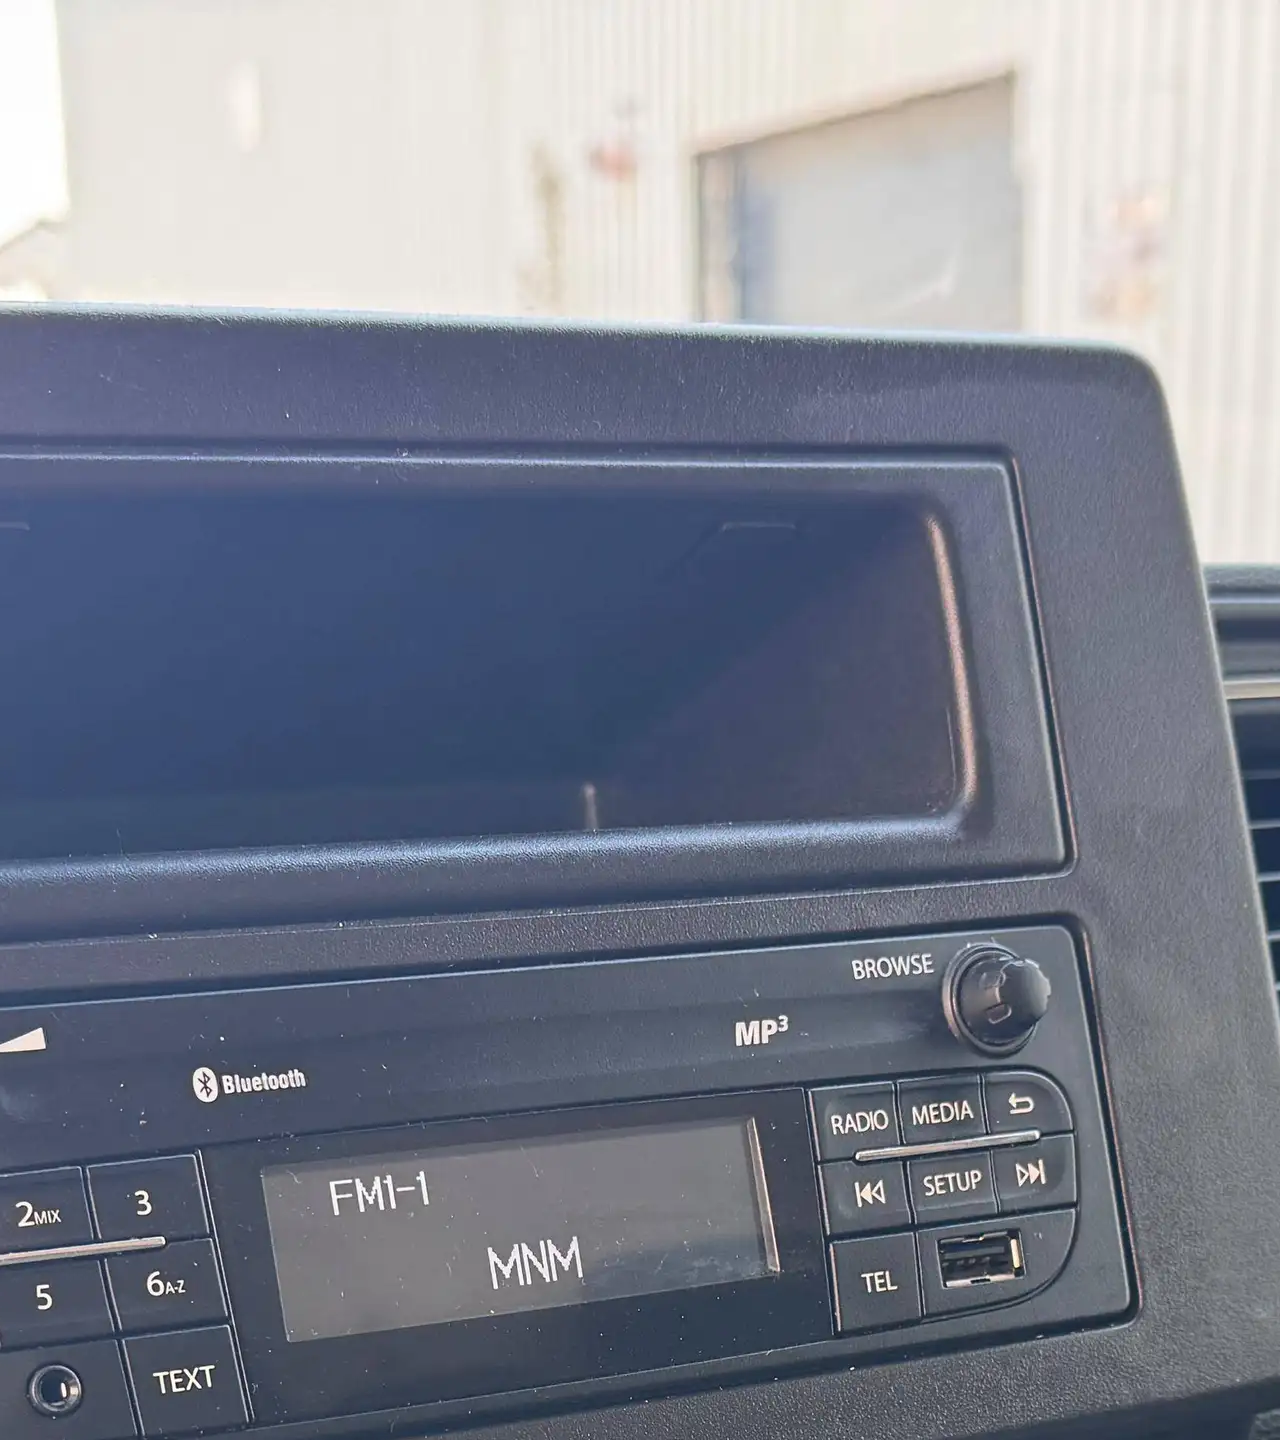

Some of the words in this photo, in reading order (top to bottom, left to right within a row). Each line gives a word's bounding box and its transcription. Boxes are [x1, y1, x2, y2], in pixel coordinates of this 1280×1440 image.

[851, 953, 935, 980] BROWSE
[222, 1068, 306, 1094] Bluetooth
[830, 1109, 889, 1136] RADIO
[911, 1099, 975, 1126] MEDIA
[329, 1170, 430, 1216] FM1-1
[923, 1169, 982, 1197] SETUP
[134, 1190, 152, 1216] 3
[487, 1235, 584, 1290] MNM
[860, 1270, 898, 1294] TEL
[36, 1284, 53, 1310] 5
[152, 1364, 216, 1394] TEXT
